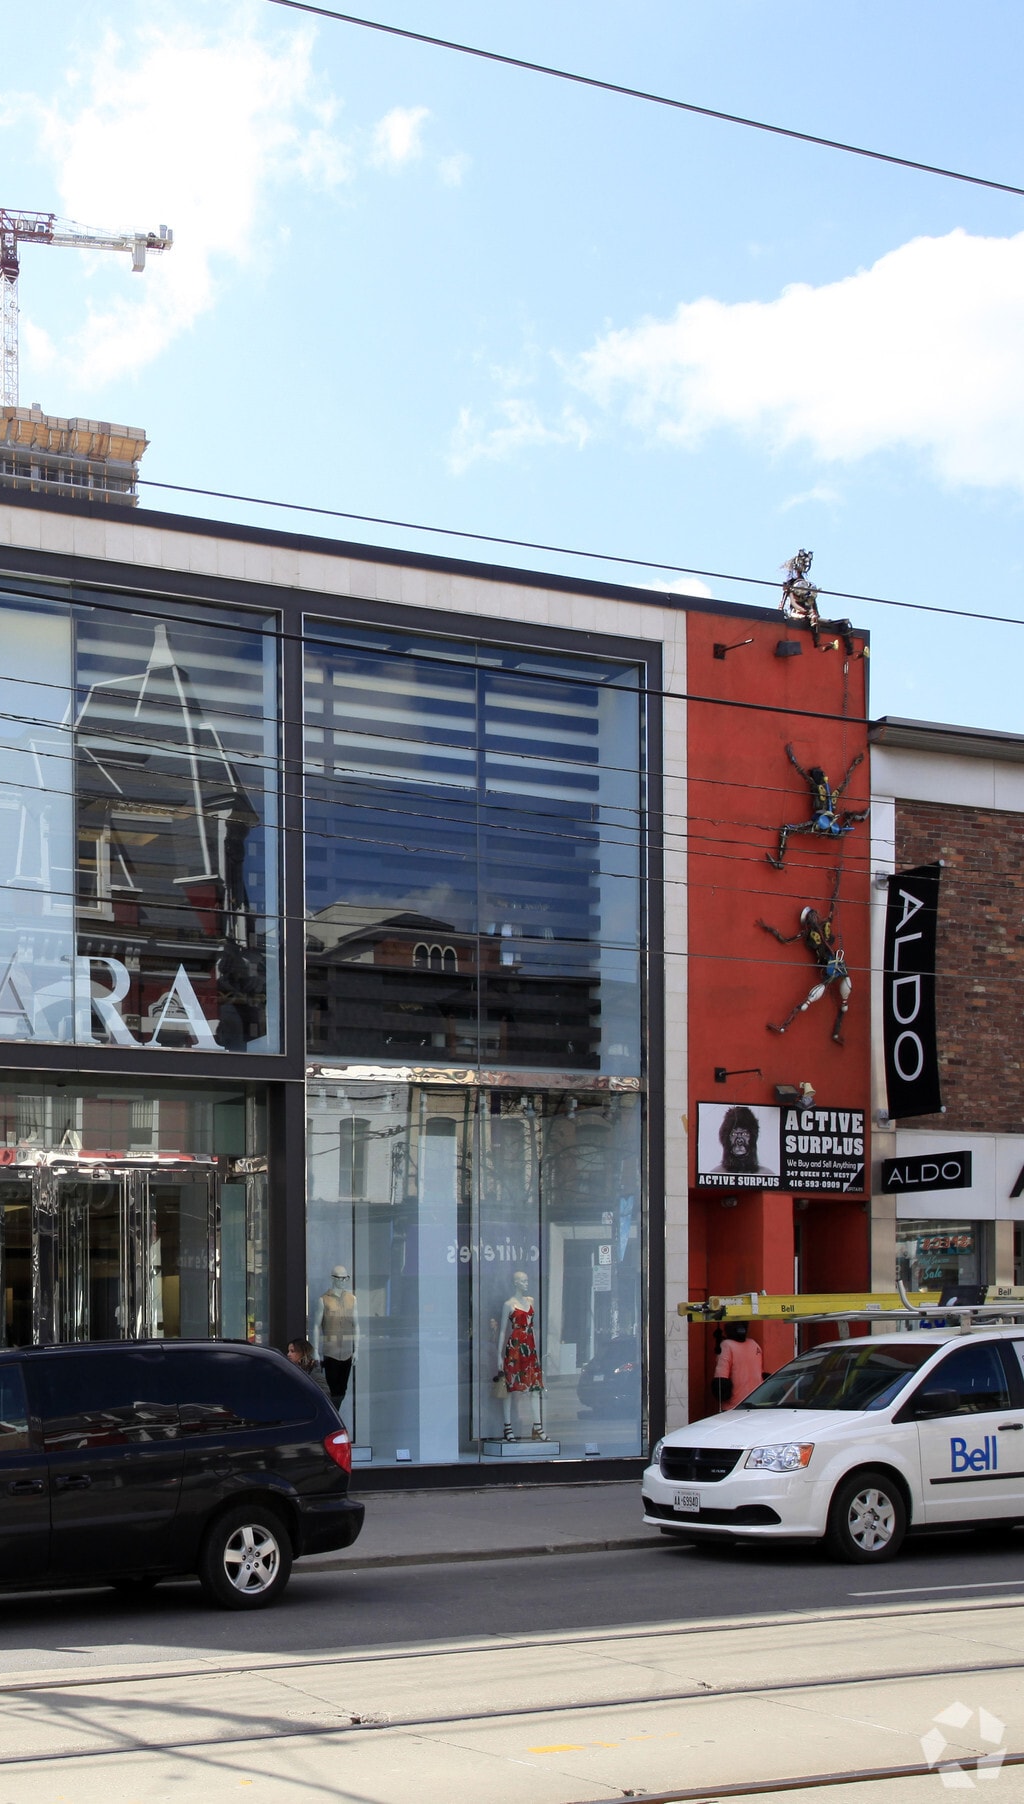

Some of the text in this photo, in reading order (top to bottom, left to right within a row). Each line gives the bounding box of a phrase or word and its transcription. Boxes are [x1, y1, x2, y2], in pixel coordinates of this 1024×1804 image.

[891, 888, 925, 1082] ALDO
[785, 1110, 864, 1134] ACTIVE
[785, 1135, 864, 1156] SURPLUS
[786, 1159, 856, 1170] We Buy and Sell Anything
[887, 1161, 962, 1185] ALDO
[698, 1175, 780, 1186] ACTIVE SURPLUS
[998, 1288, 1012, 1296] Bell
[781, 1304, 795, 1312] Bell
[950, 1435, 998, 1473] Bell
